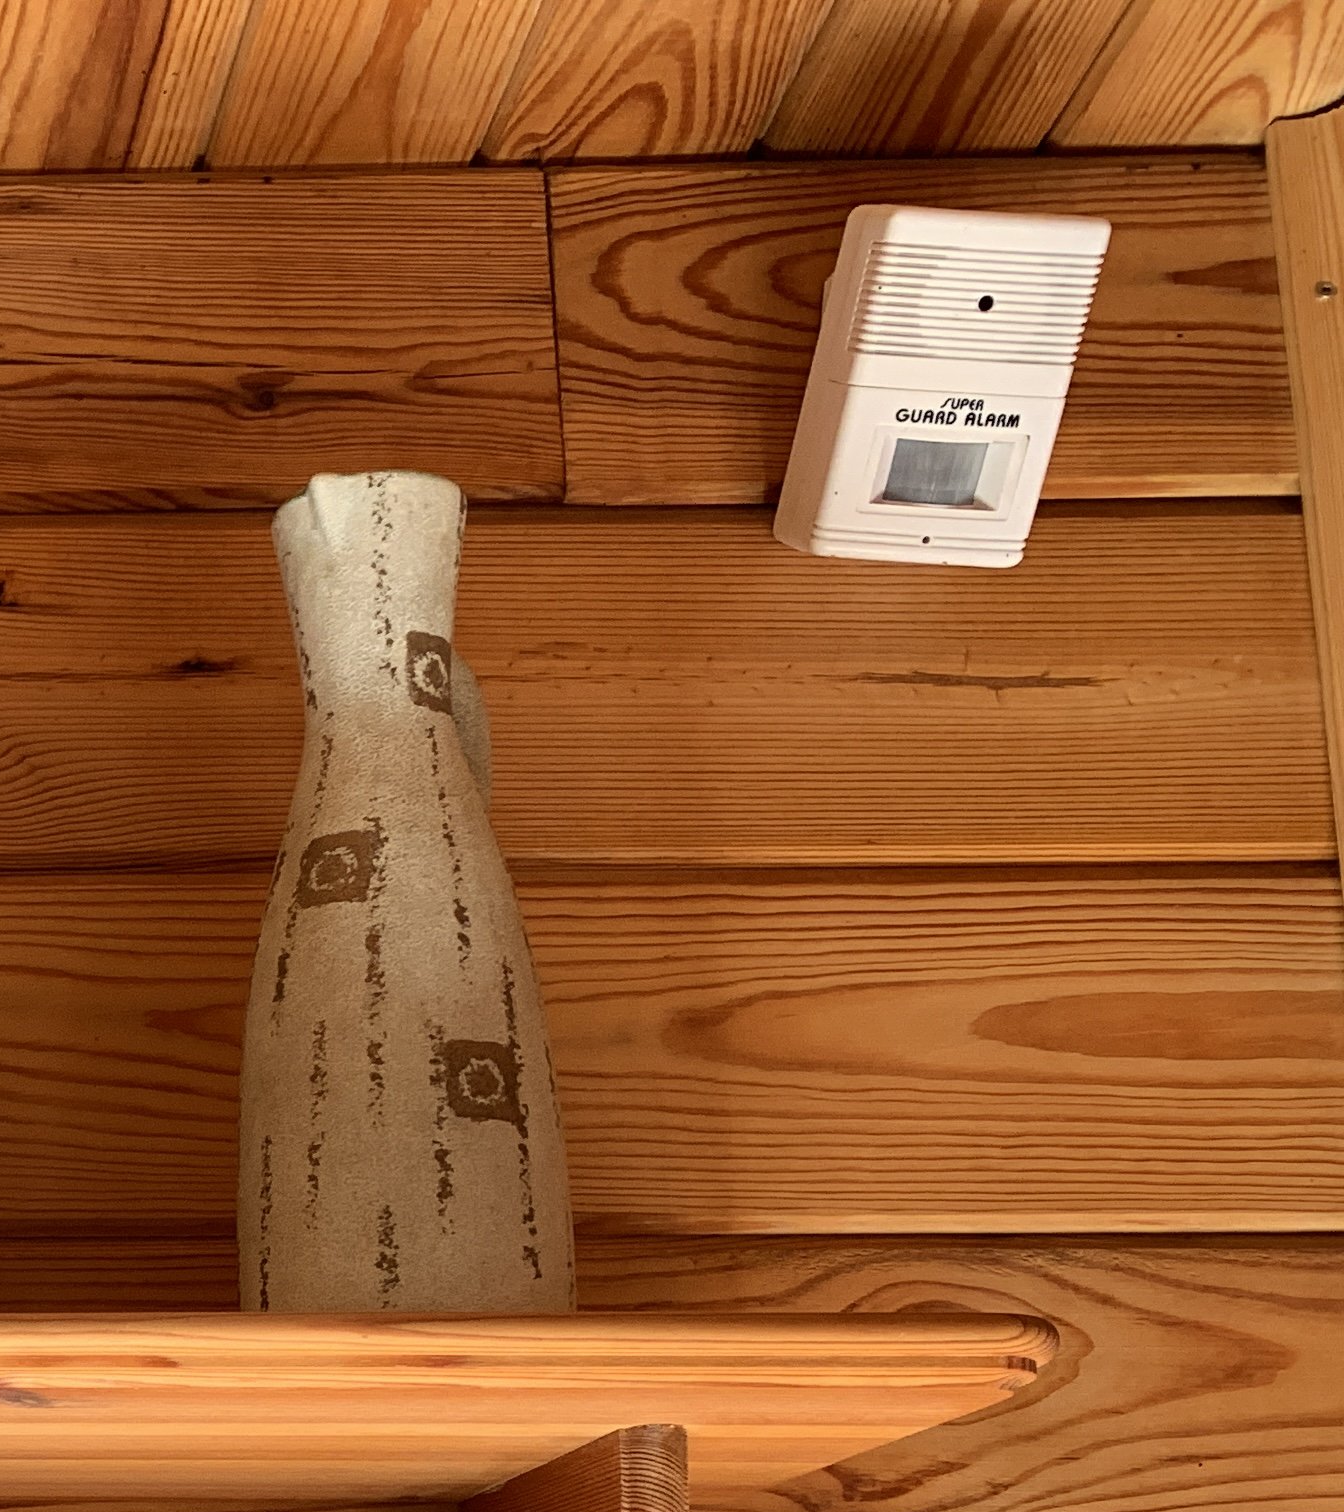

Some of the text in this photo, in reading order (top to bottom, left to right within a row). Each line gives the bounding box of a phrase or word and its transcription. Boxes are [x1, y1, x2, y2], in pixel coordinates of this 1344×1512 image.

[940, 397, 984, 412] SUPER
[895, 408, 1020, 428] GUARD ALARM
